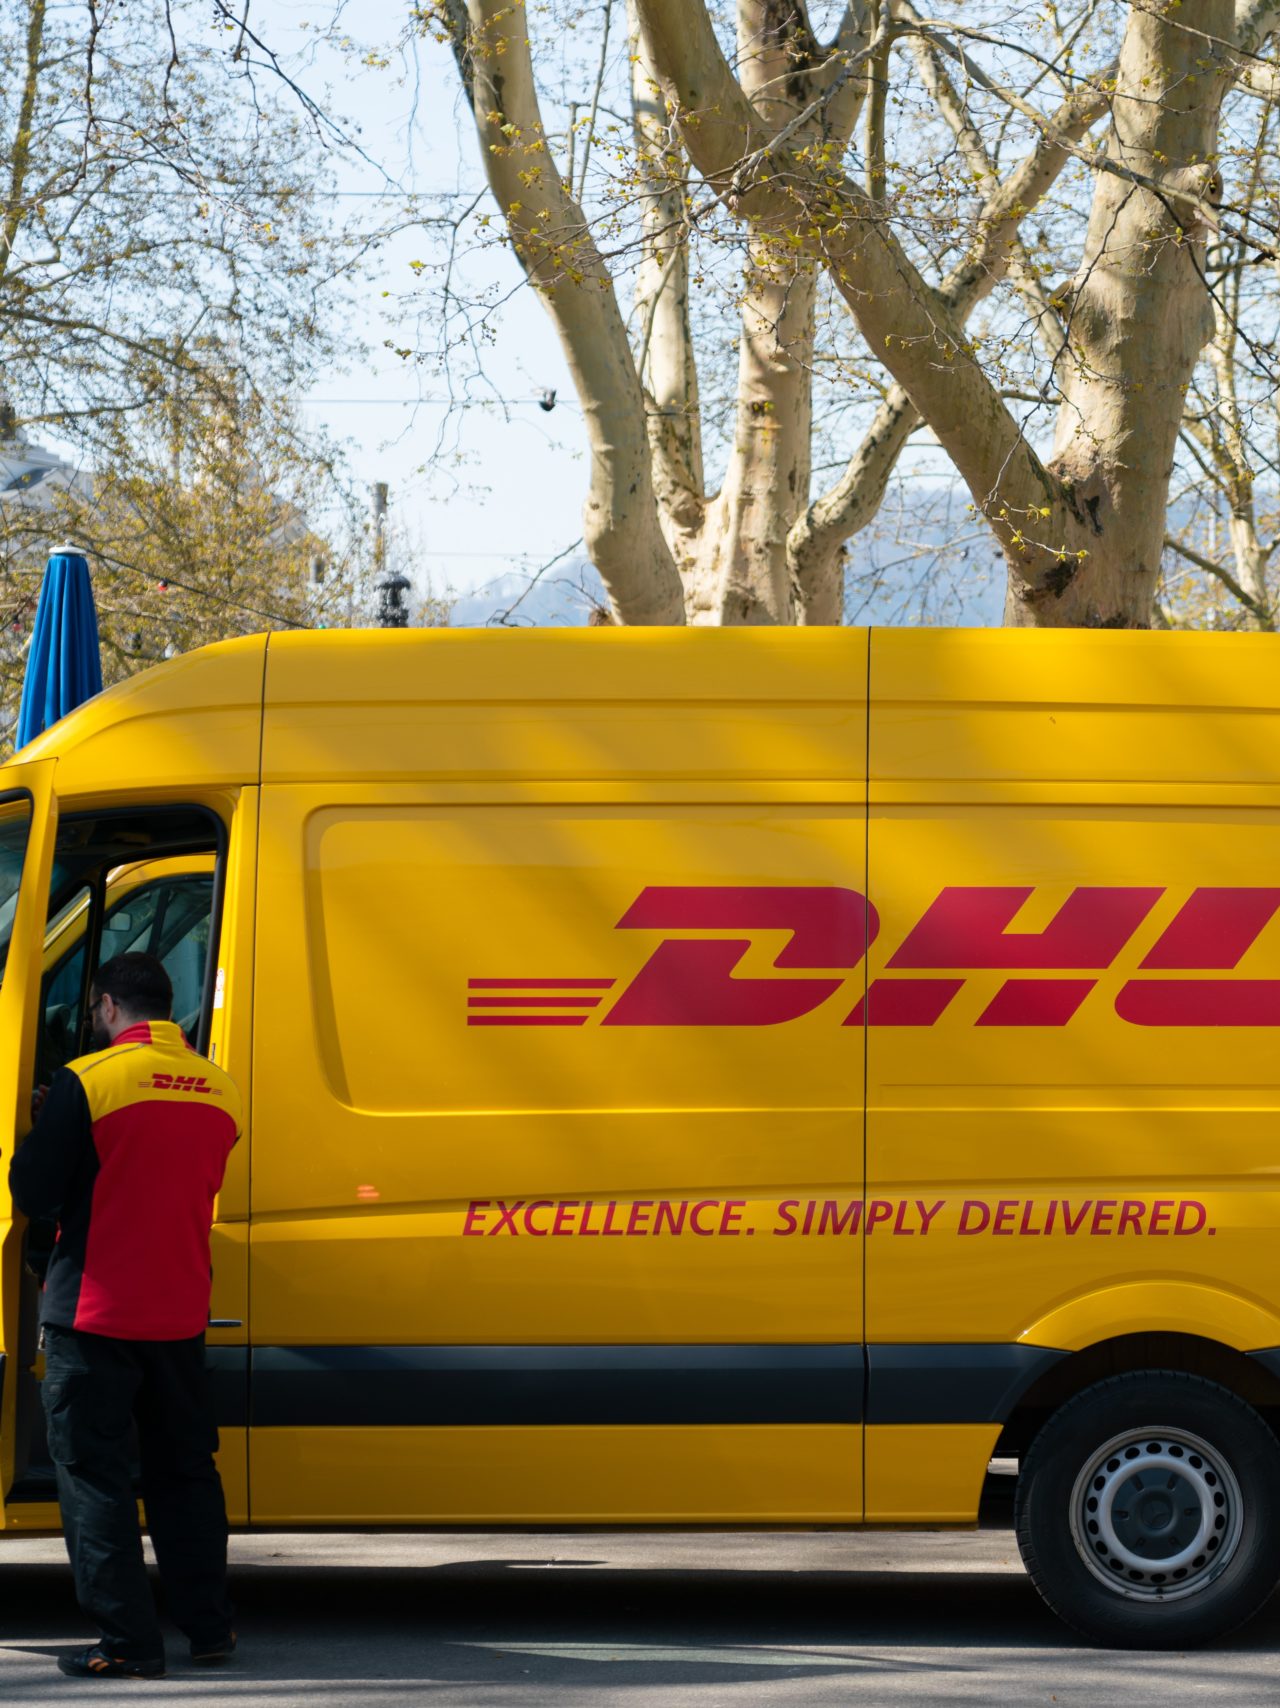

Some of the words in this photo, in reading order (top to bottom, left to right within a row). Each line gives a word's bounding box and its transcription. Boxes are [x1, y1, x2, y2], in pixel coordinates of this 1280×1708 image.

[152, 1073, 212, 1094] DHL
[463, 1200, 755, 1236] EXCELLENCE.
[773, 1200, 945, 1236] SIMPLY
[957, 1200, 1216, 1236] DELIVERED.
